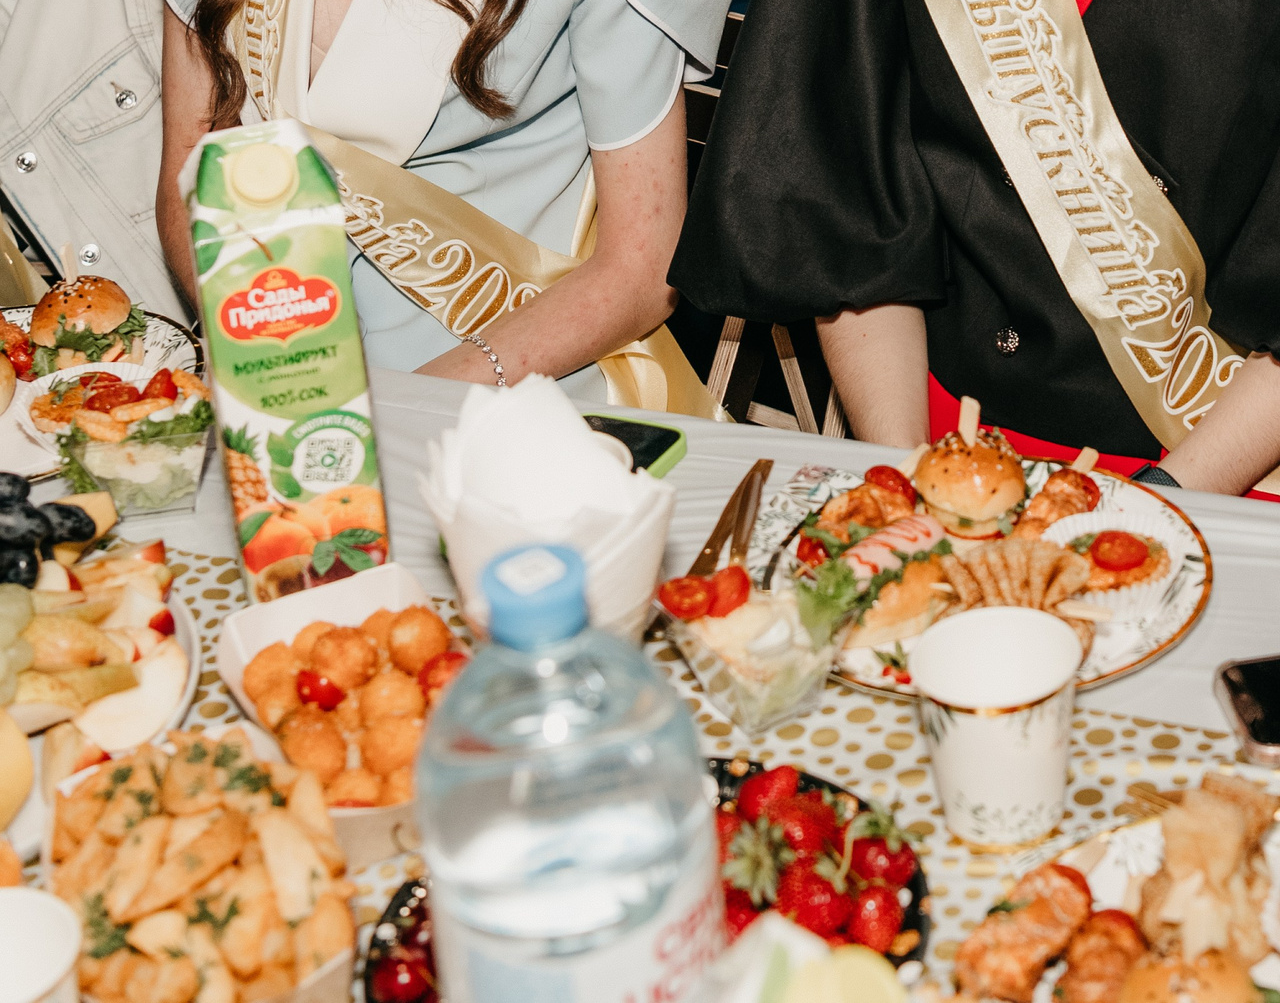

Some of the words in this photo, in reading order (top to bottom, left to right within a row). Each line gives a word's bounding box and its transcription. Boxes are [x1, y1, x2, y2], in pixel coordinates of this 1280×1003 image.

[247, 285, 306, 308] Сады
[228, 296, 331, 330] Придонья
[261, 389, 296, 408] 100%
